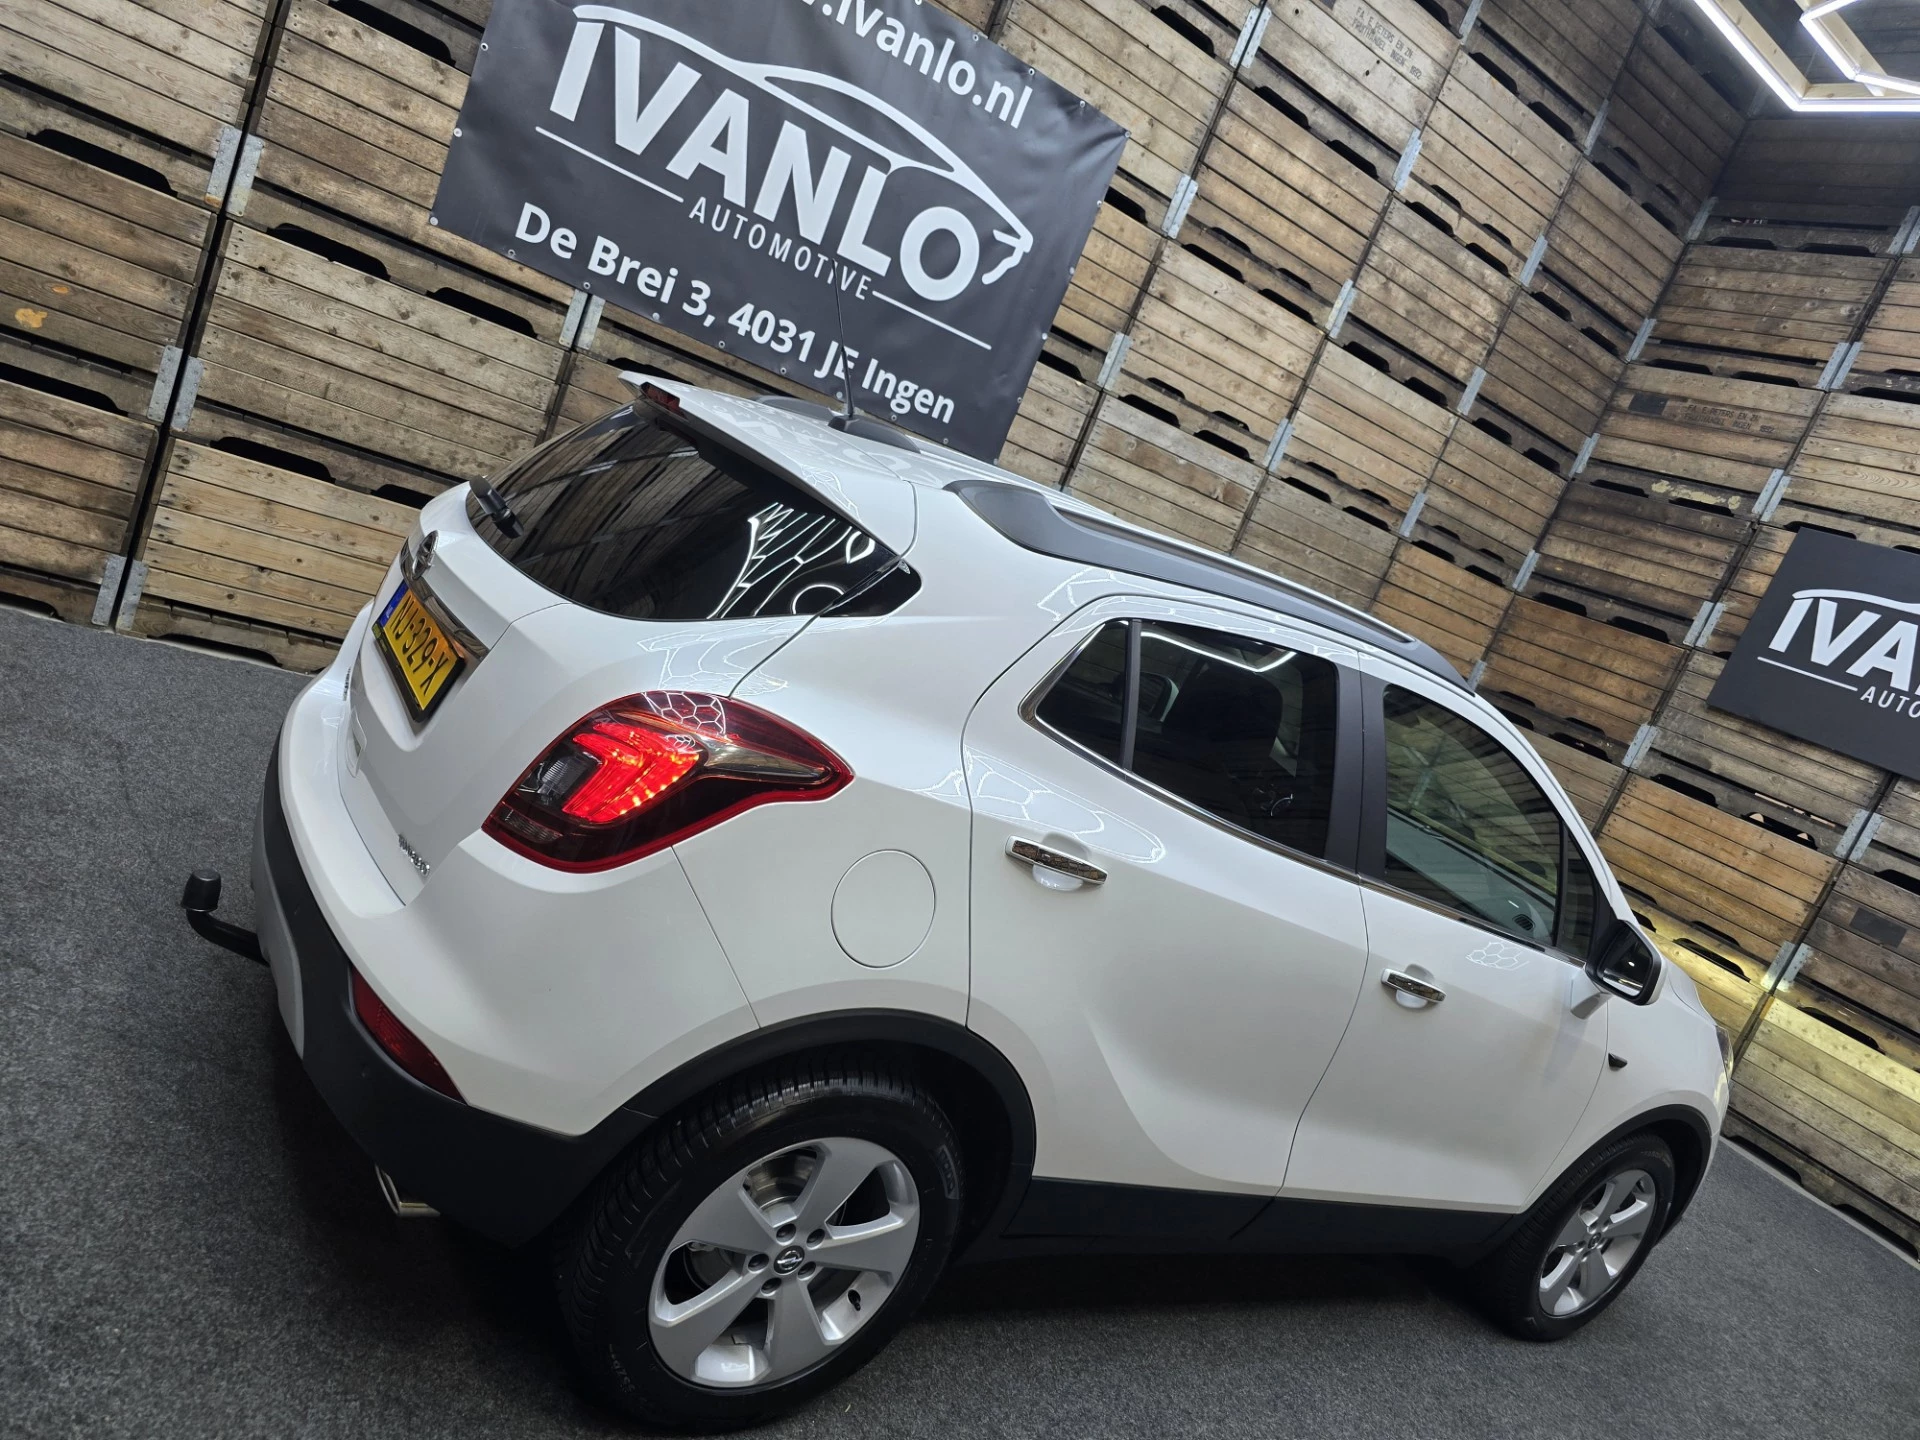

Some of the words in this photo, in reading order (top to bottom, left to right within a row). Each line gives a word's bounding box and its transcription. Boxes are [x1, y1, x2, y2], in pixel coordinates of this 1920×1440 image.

[549, 21, 980, 302] IVANLO
[688, 196, 872, 300] AUTOMOTIVE
[515, 201, 577, 259] De
[587, 235, 679, 304] Brei
[682, 279, 715, 327] 3,
[728, 303, 816, 363] 4031
[813, 340, 859, 380] JE
[861, 358, 955, 424] Ingen
[389, 594, 449, 697] NJ-329-X
[1768, 598, 1920, 696] IVA
